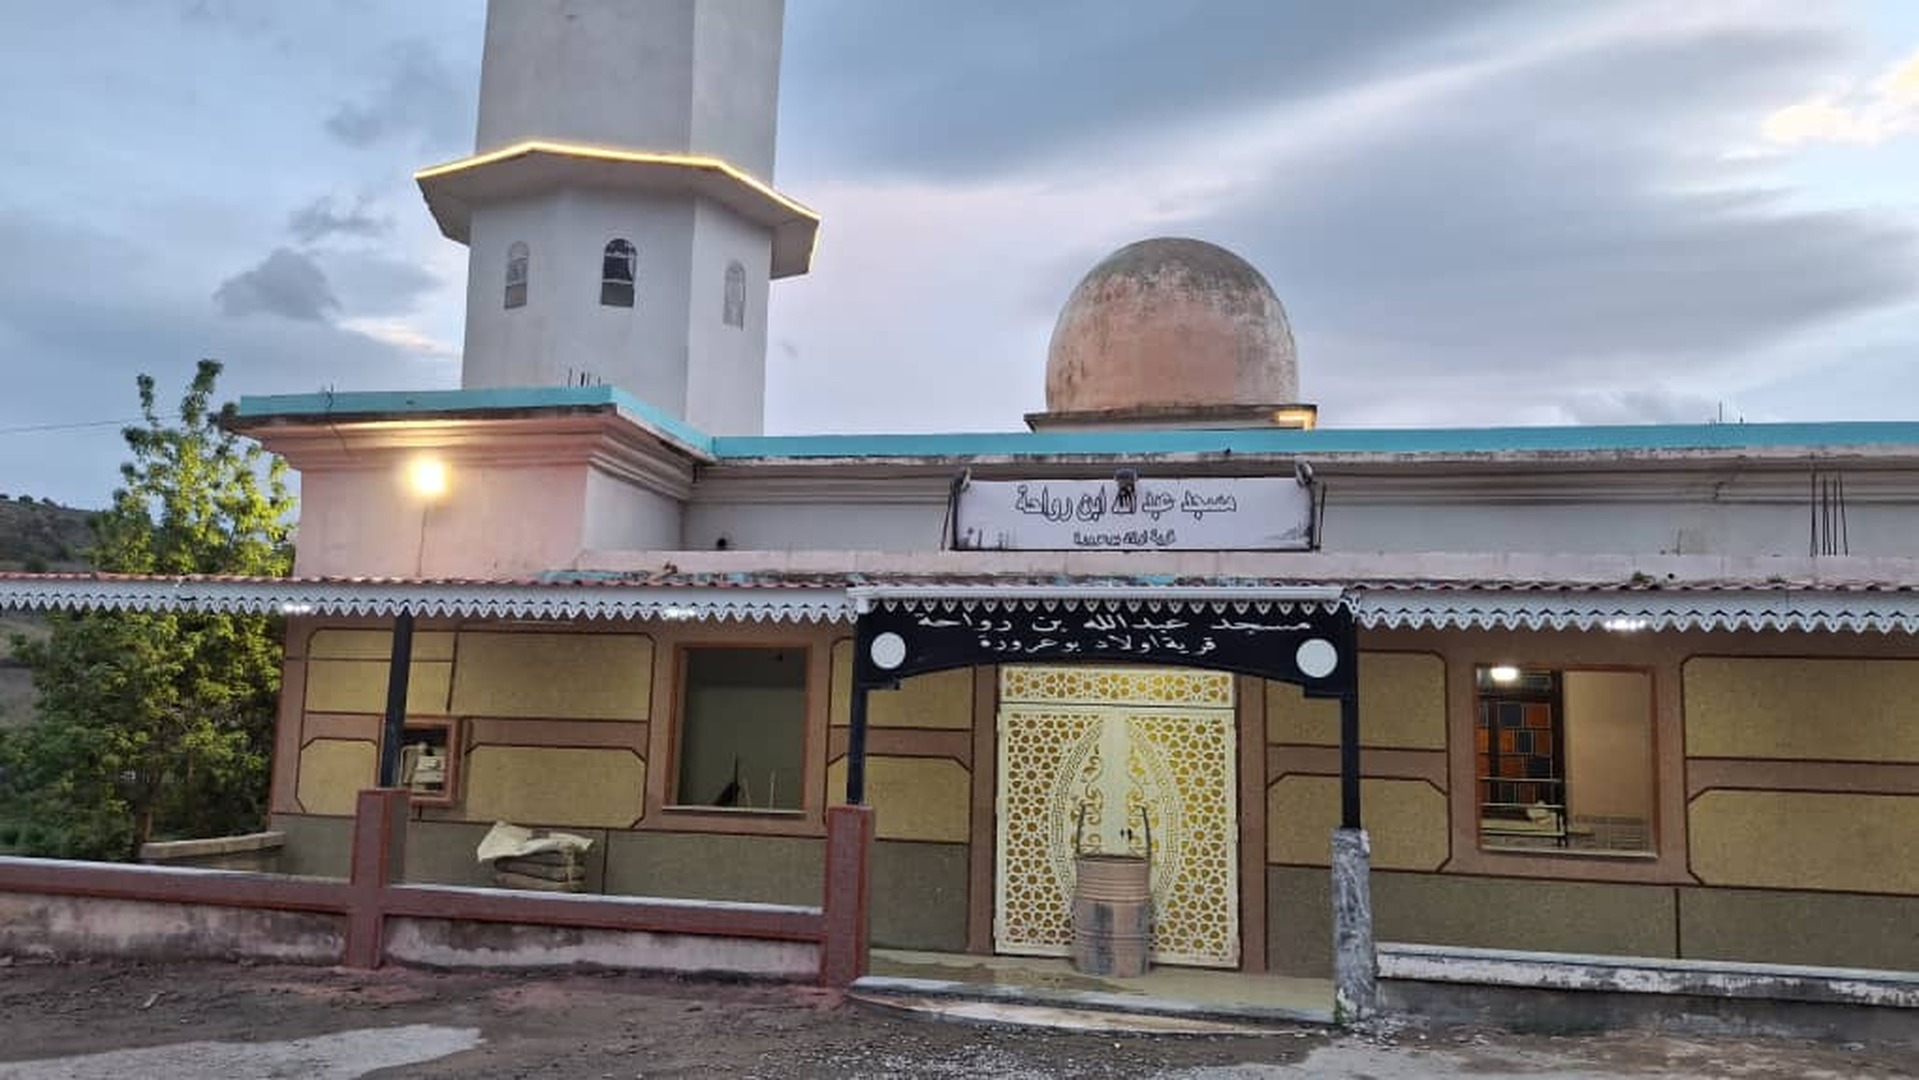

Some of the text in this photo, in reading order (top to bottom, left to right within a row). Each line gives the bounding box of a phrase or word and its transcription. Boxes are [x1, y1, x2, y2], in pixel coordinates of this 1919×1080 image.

[1016, 484, 1074, 522] رواحة
[1141, 491, 1175, 521] عبد
[1181, 490, 1237, 521] مسجد
[914, 612, 1013, 632] رواحة
[1031, 616, 1068, 633] بن
[1209, 618, 1311, 635] مسجد
[1164, 636, 1217, 655] قرية
